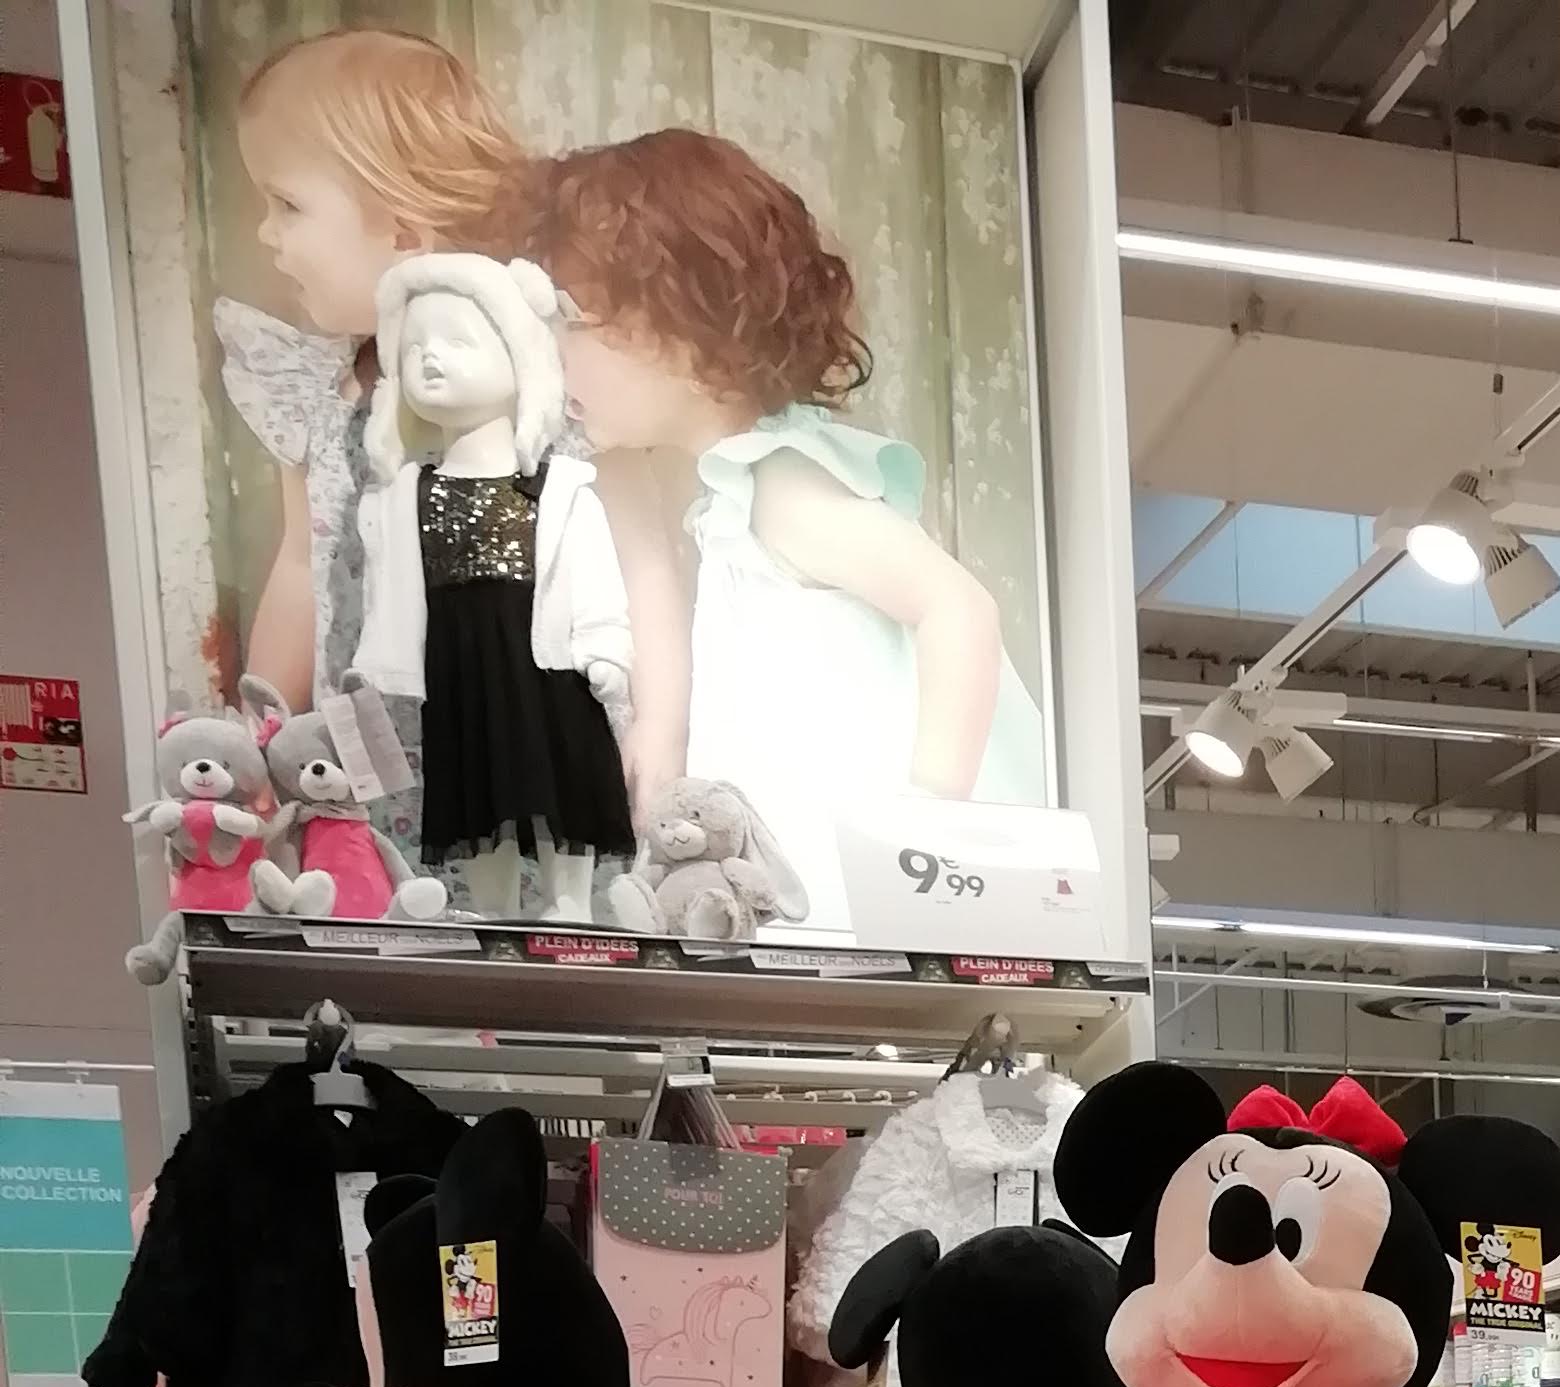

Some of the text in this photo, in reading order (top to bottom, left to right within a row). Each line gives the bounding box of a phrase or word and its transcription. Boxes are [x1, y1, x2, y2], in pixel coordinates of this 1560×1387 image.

[535, 935, 579, 951] PLEIN
[558, 953, 611, 964] CADEAUX
[960, 958, 998, 971] PLEIN
[981, 973, 1029, 984] CADEAUX
[0, 1166, 101, 1182] NOUVELLE
[1, 1185, 122, 1202] COLLECTION
[1511, 1268, 1535, 1290] 90
[1470, 1302, 1542, 1321] MICKEY
[448, 1320, 497, 1338] MICKEY
